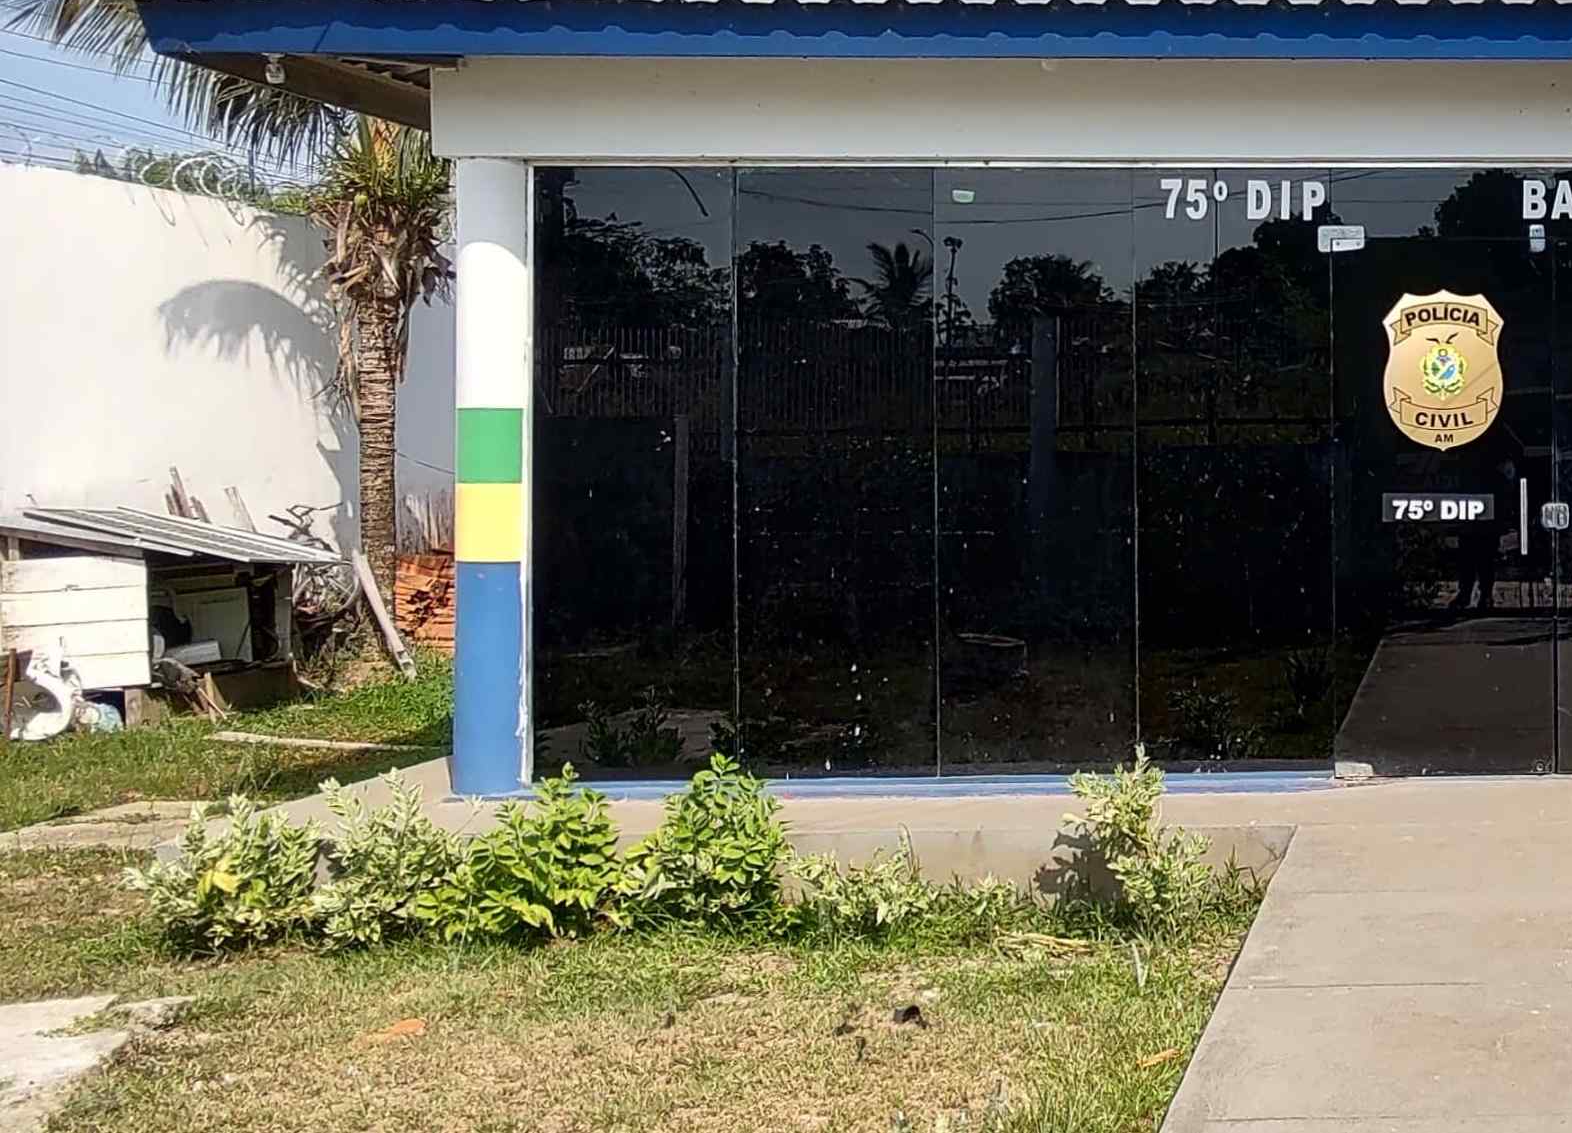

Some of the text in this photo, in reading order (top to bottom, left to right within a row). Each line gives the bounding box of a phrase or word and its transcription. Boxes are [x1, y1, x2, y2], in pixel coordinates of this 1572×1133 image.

[1247, 179, 1326, 221] DIP
[1404, 305, 1480, 327] POLÍCIA
[1415, 412, 1474, 428] CIVIL
[1434, 434, 1454, 443] AM
[1440, 500, 1485, 521] DIP
